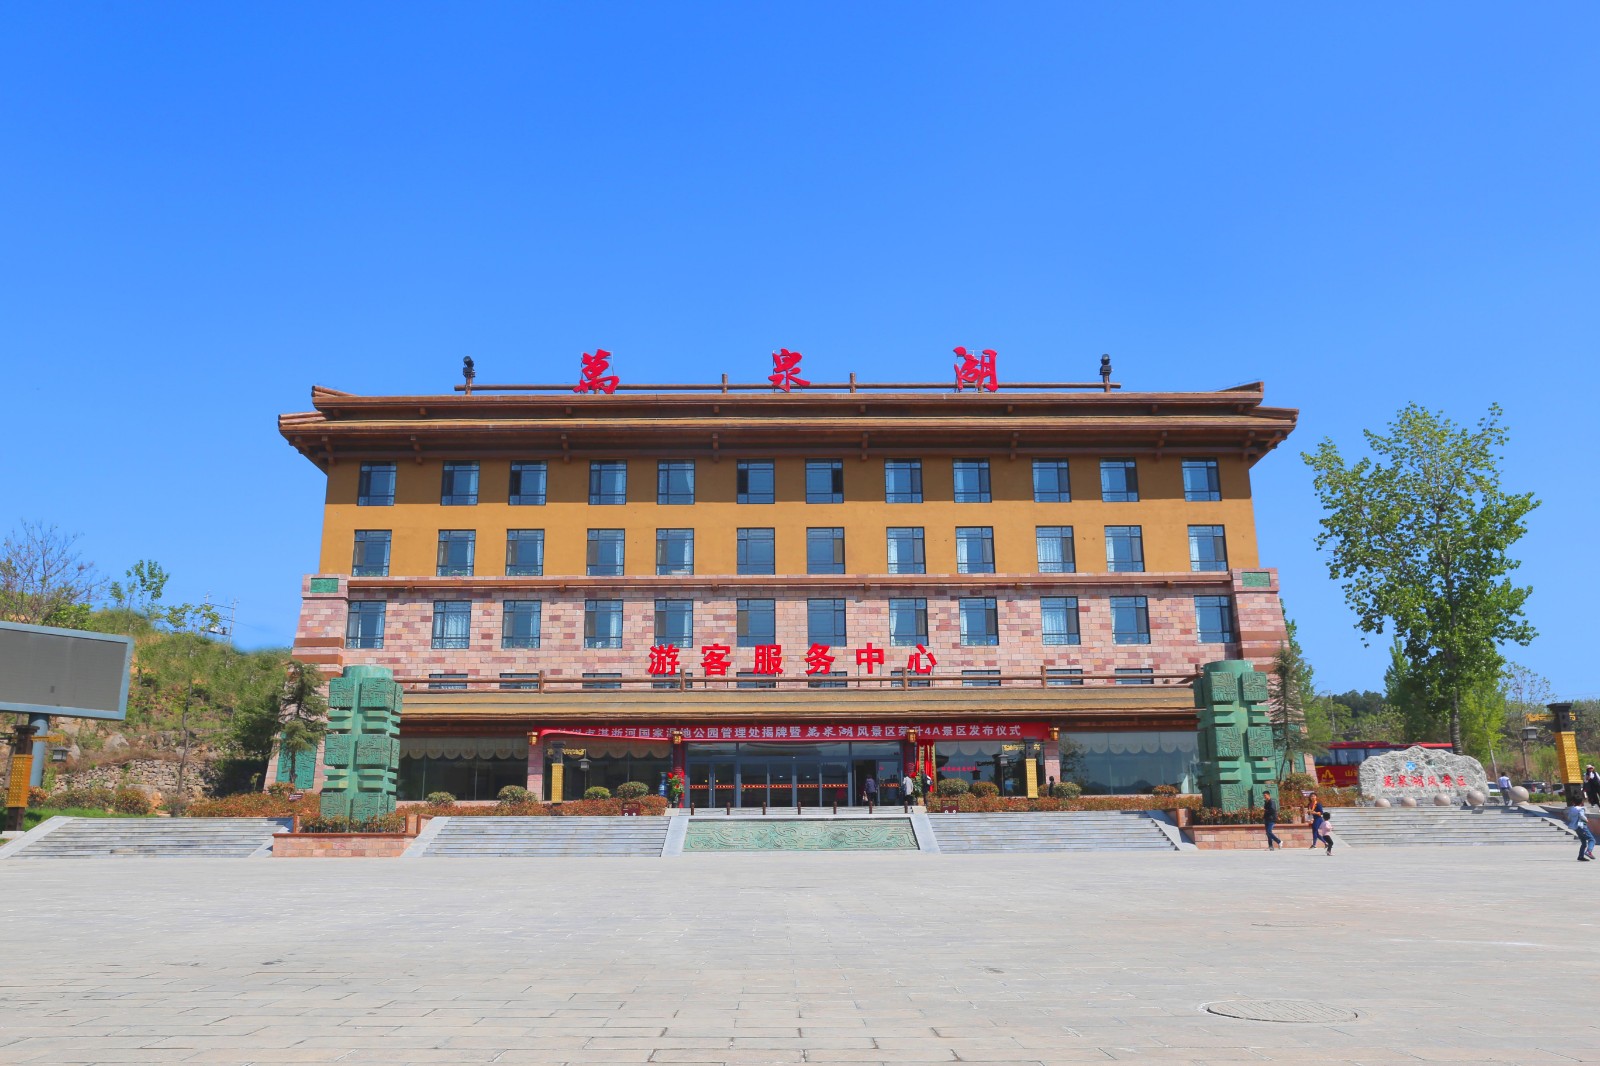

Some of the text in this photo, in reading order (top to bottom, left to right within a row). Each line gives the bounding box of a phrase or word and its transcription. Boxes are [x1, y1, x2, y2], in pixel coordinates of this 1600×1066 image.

[647, 643, 937, 676] 游客服务中心
